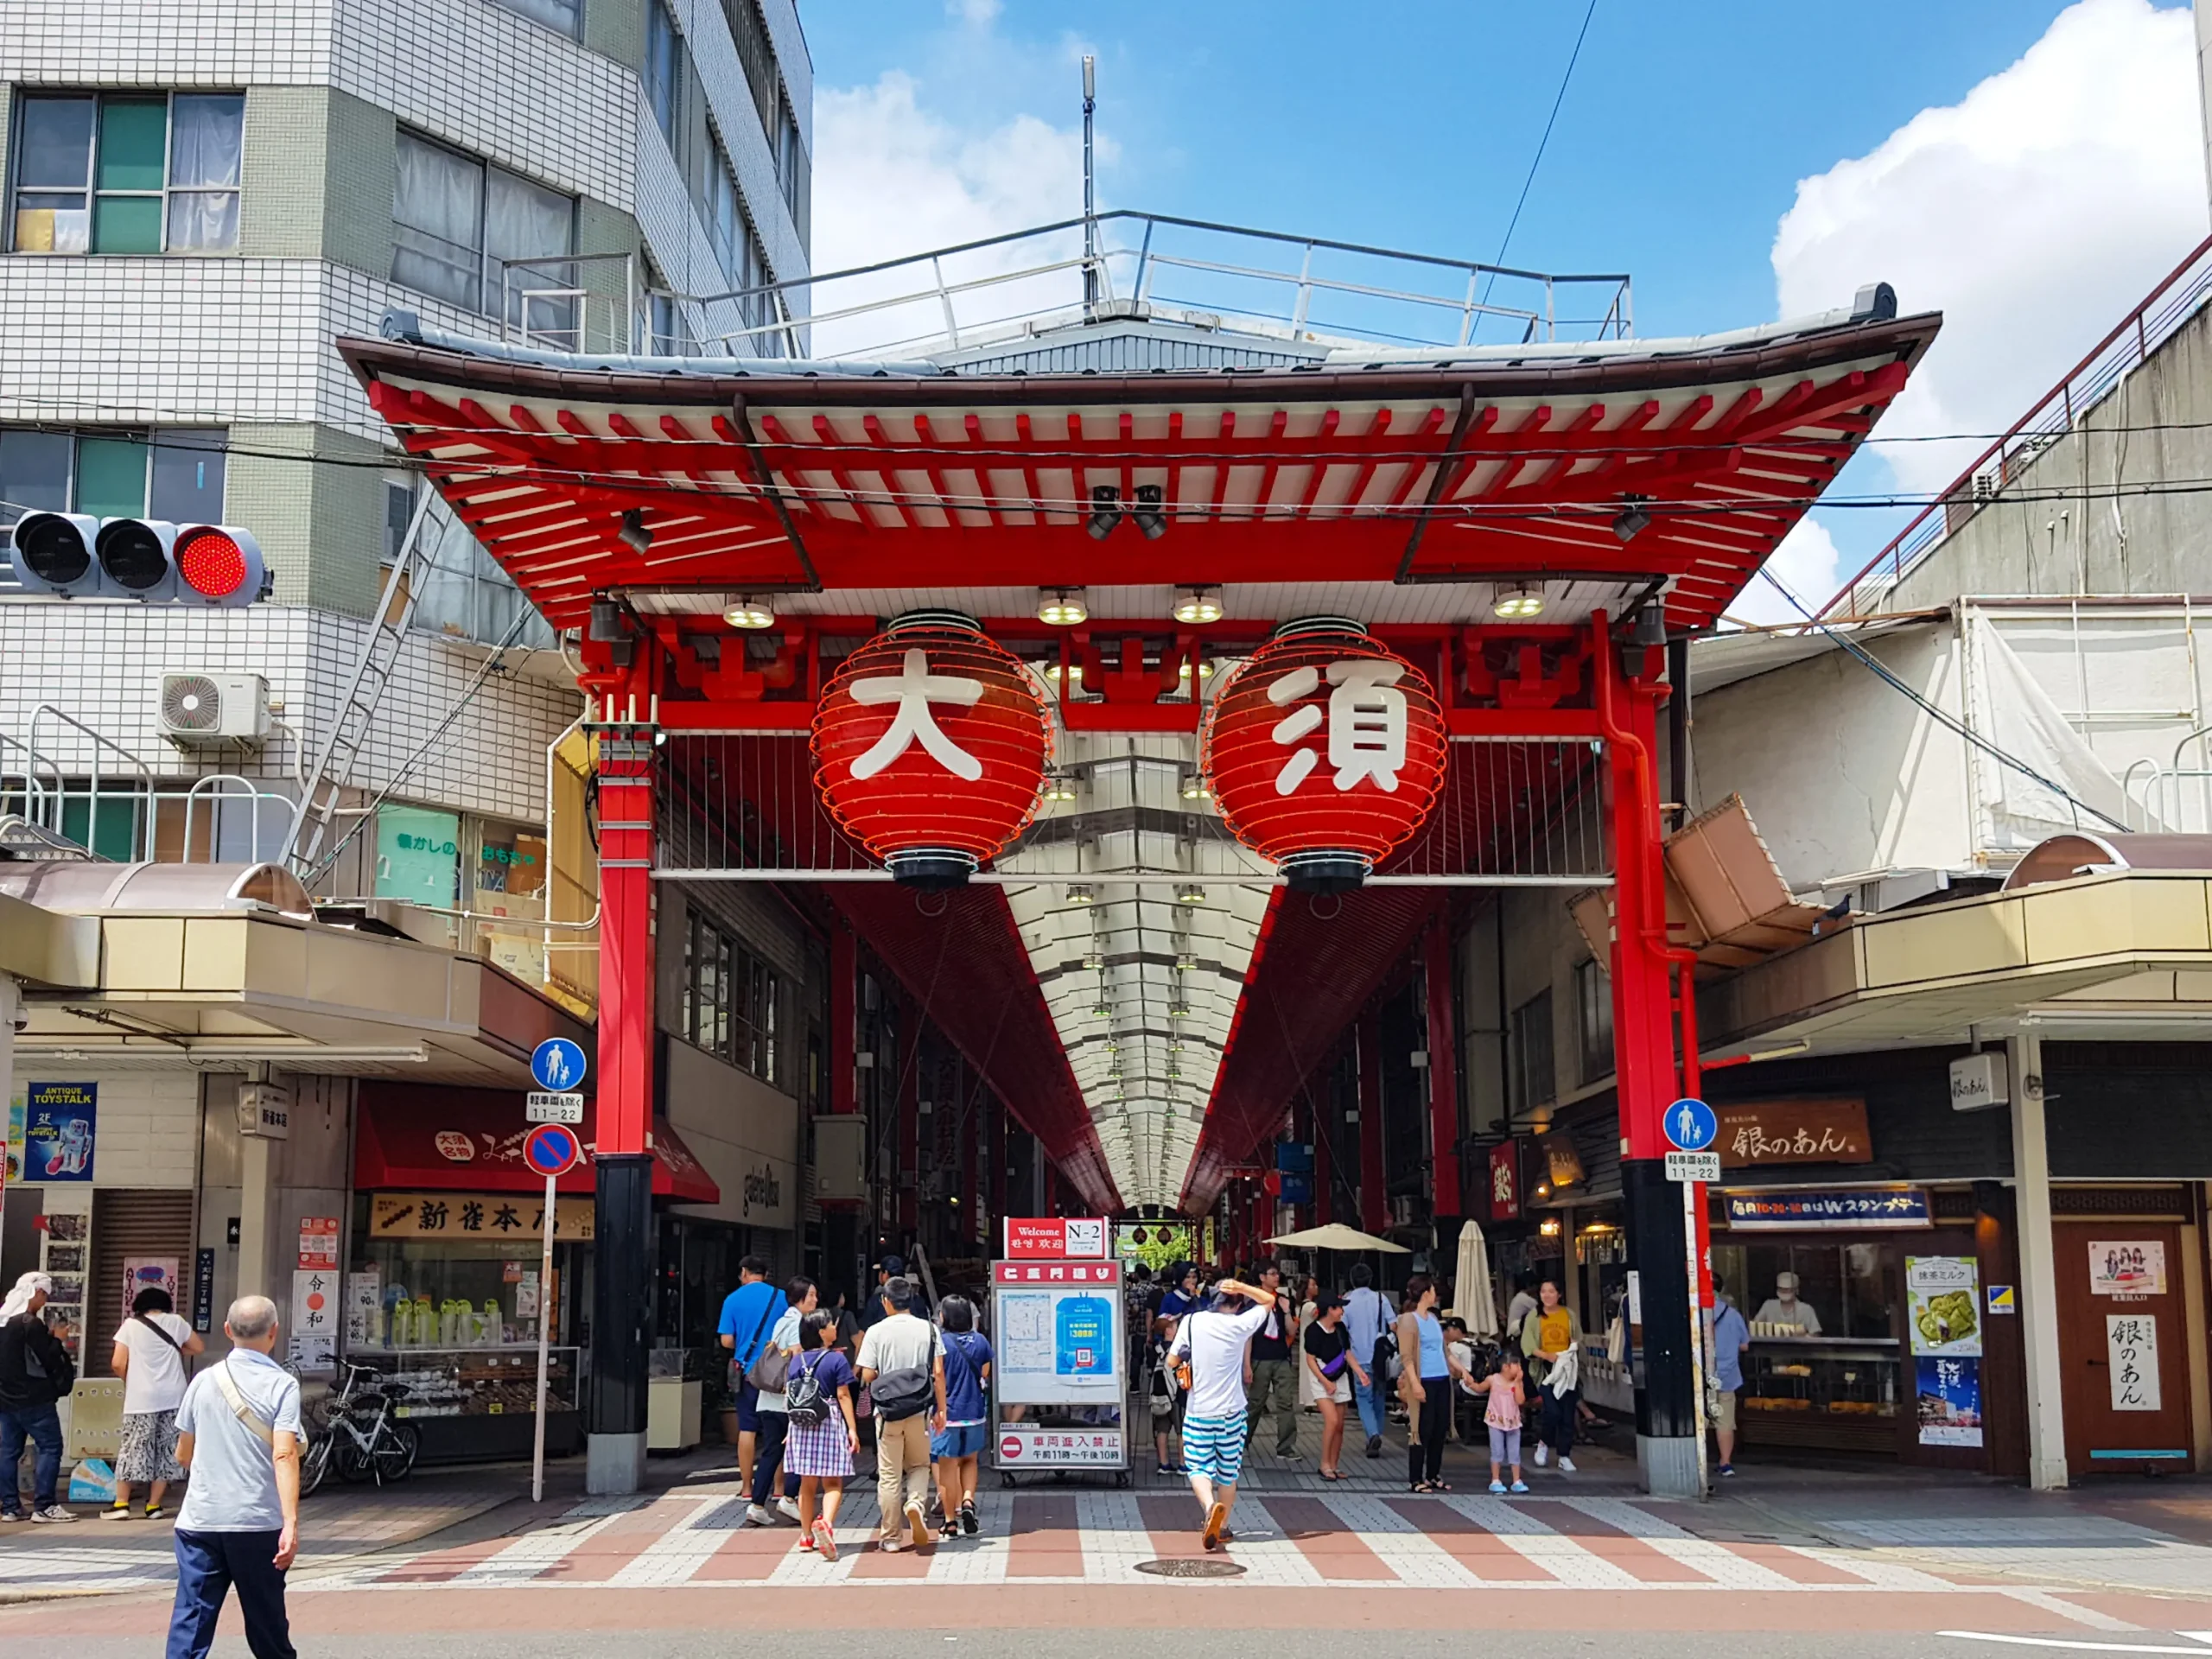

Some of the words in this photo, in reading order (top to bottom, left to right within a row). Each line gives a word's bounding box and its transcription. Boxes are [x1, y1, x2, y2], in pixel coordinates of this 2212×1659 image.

[849, 648, 984, 782] 大
[1267, 659, 1408, 796] 須
[34, 1095, 92, 1103] TOYSTALK
[38, 1113, 51, 1122] 2F
[438, 1134, 467, 1146] 大須
[442, 1145, 472, 1159] 名物
[1018, 1227, 1060, 1236] Welcome
[1011, 1239, 1033, 1249] 환영
[1039, 1239, 1064, 1249] 欢迎
[2111, 1320, 2143, 1404] 銀のあん
[1033, 1436, 1119, 1447] 車両進入禁止
